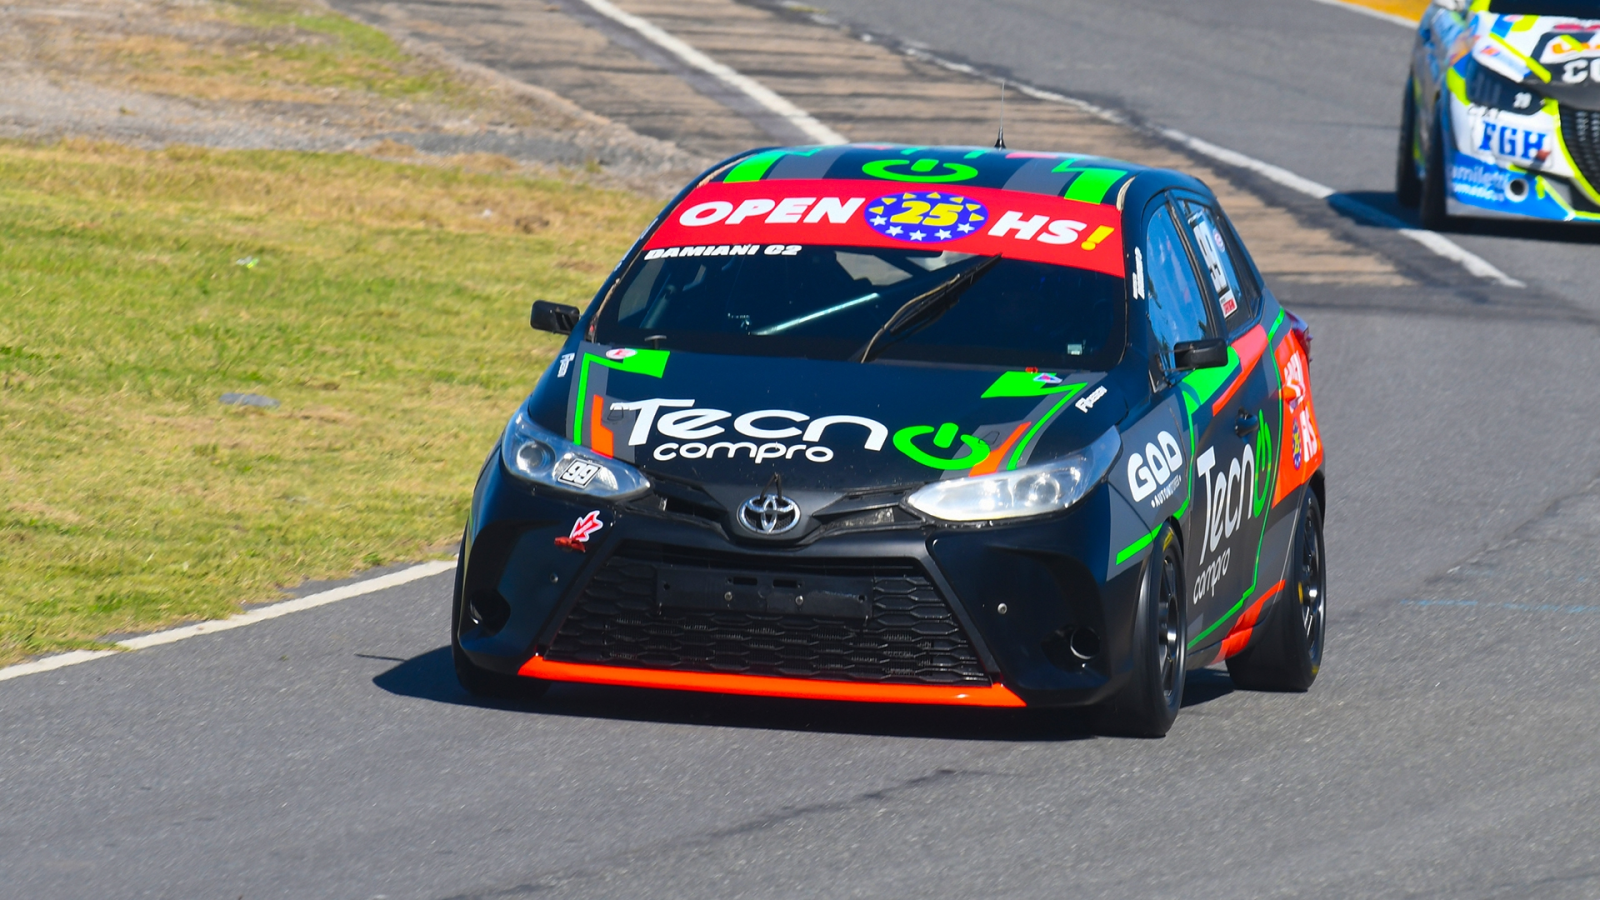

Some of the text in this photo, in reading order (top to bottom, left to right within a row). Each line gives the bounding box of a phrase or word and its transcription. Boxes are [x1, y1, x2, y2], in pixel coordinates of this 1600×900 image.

[1478, 121, 1548, 160] FGH
[679, 197, 1115, 251] OPEN 25 HS!
[644, 244, 760, 261] DAMIANI
[653, 441, 834, 463] compro
[561, 460, 600, 486] 99
[1192, 547, 1231, 605] compro
